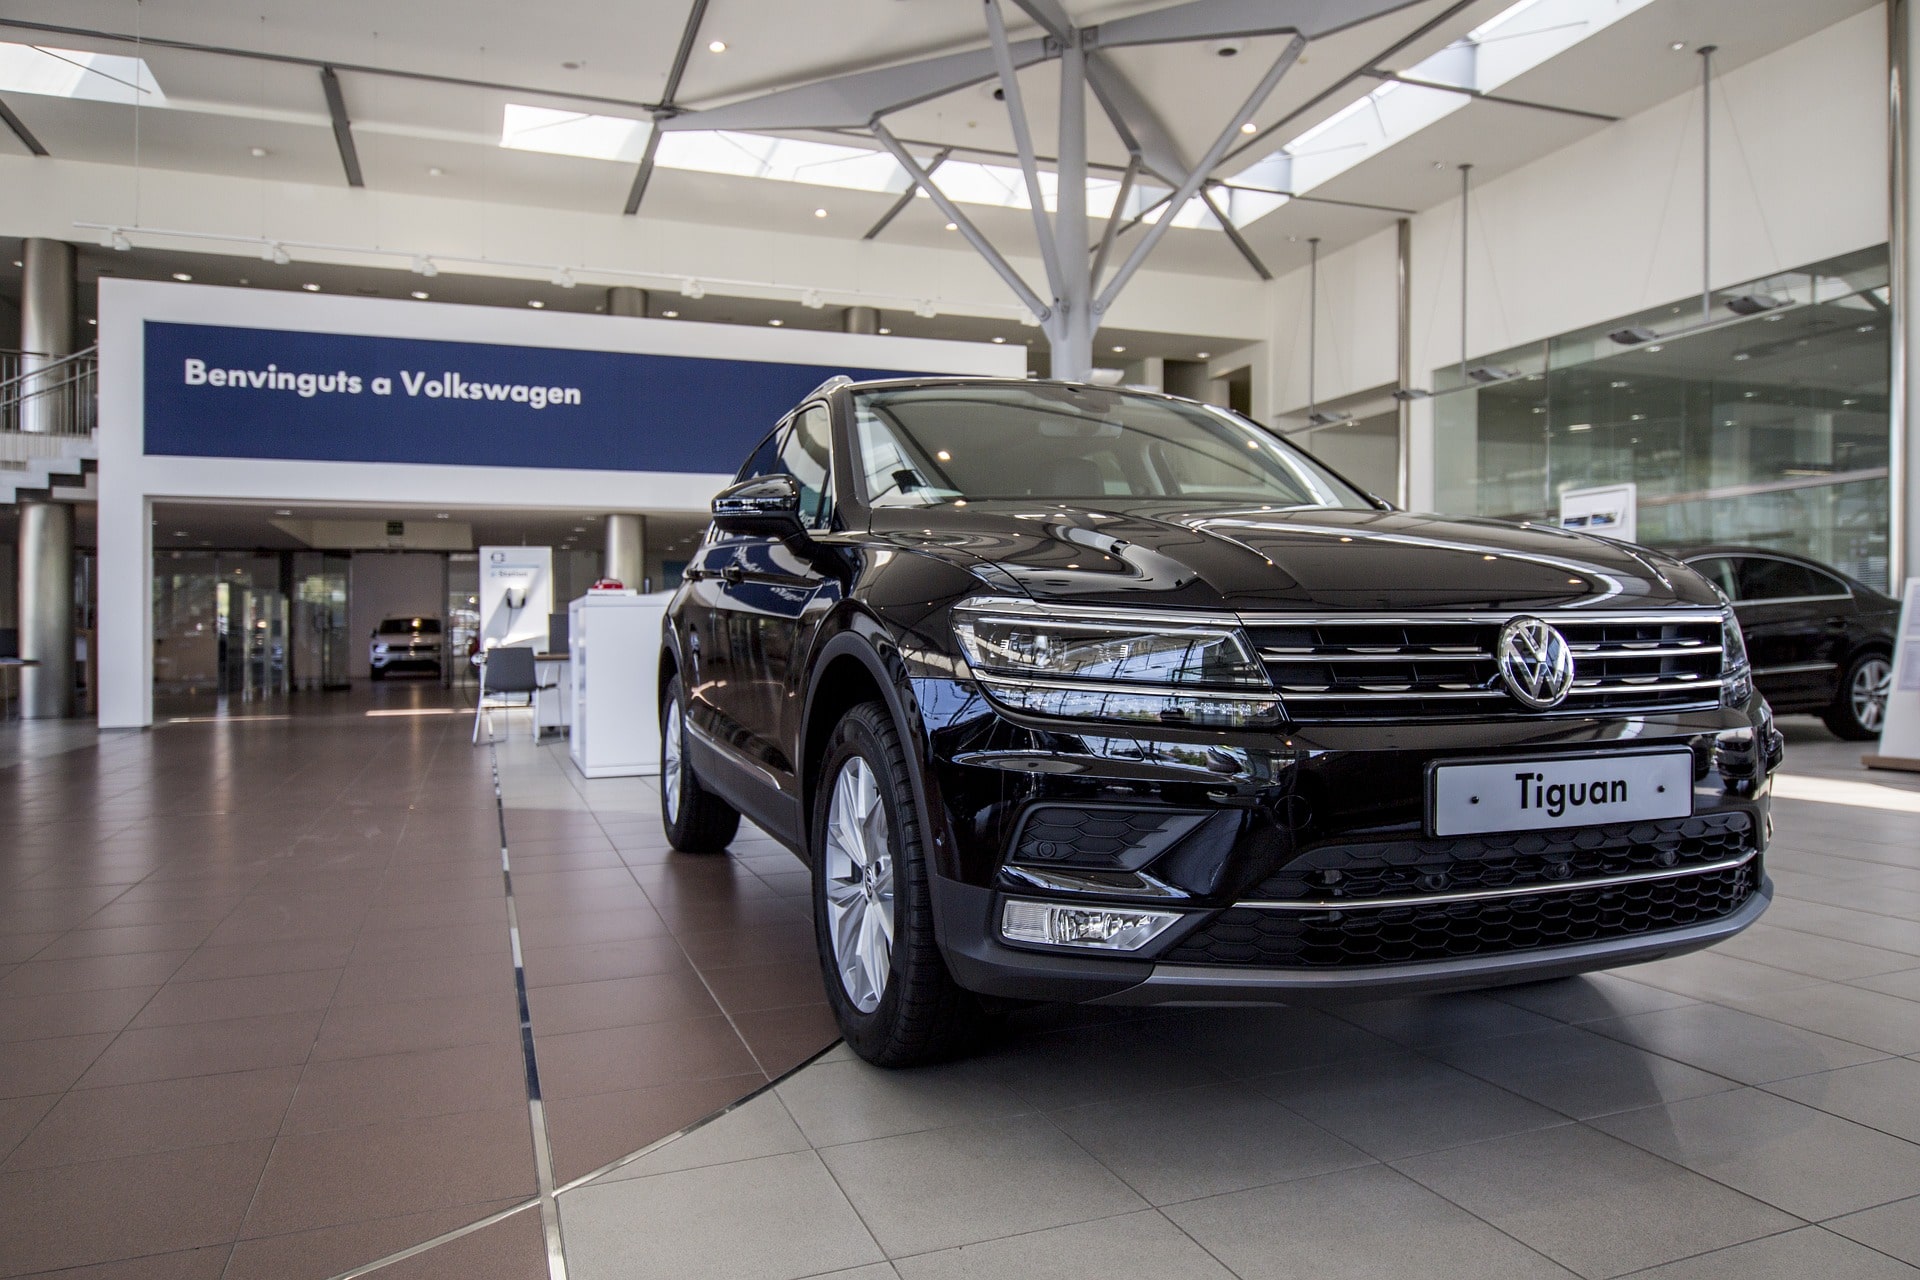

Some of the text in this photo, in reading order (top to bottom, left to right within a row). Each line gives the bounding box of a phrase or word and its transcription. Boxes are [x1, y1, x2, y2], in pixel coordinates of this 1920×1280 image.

[185, 358, 581, 410] Benvinguts a Volkswagen
[1514, 772, 1628, 818] Tiguan
